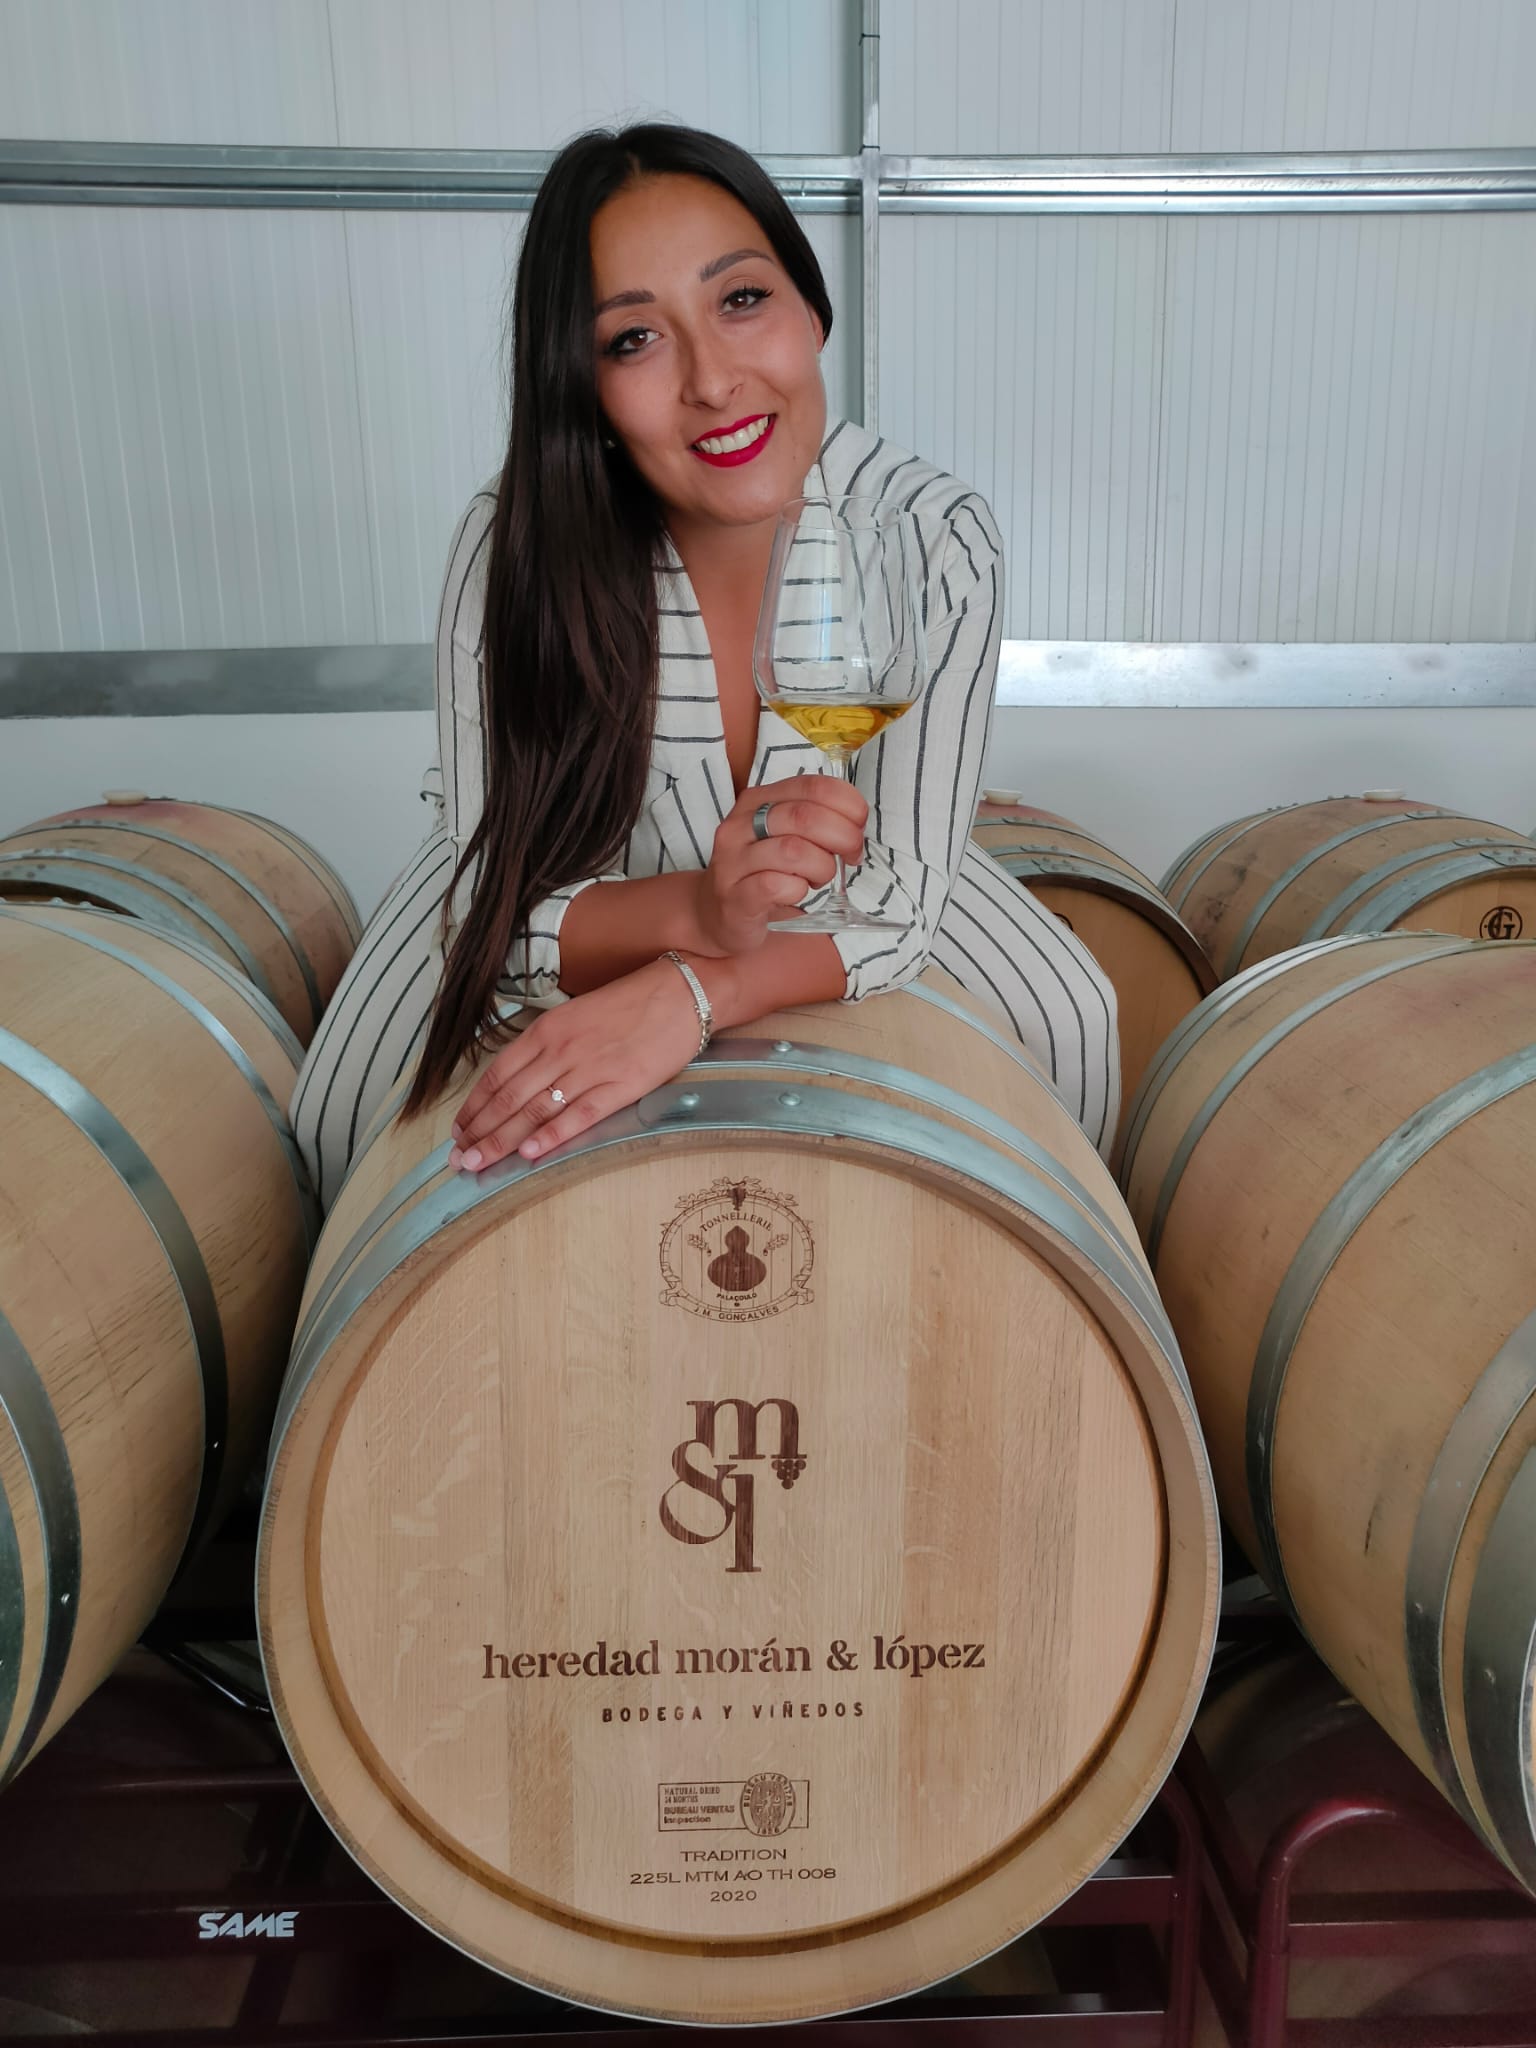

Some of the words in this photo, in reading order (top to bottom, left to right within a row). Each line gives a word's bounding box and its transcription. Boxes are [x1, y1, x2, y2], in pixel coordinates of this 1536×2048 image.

[699, 1212, 774, 1232] TONNELLERIE
[718, 1305, 779, 1322] GONÇALVES
[482, 1639, 661, 1679] heredad
[675, 1637, 812, 1674] morán
[826, 1639, 859, 1671] &
[873, 1634, 986, 1678] lópez
[602, 1705, 703, 1723] BODEGA
[723, 1705, 733, 1720] Y
[752, 1701, 864, 1719] VIÑEDOS
[664, 1806, 699, 1815] BUREAU
[700, 1805, 735, 1813] VERITAS
[680, 1849, 787, 1862] TRADITION
[630, 1872, 681, 1885] 225L
[685, 1870, 729, 1882] MTM
[767, 1869, 793, 1880] TH
[798, 1867, 837, 1880] 008
[710, 1890, 757, 1902] 2020
[198, 1911, 300, 1939] SAME
